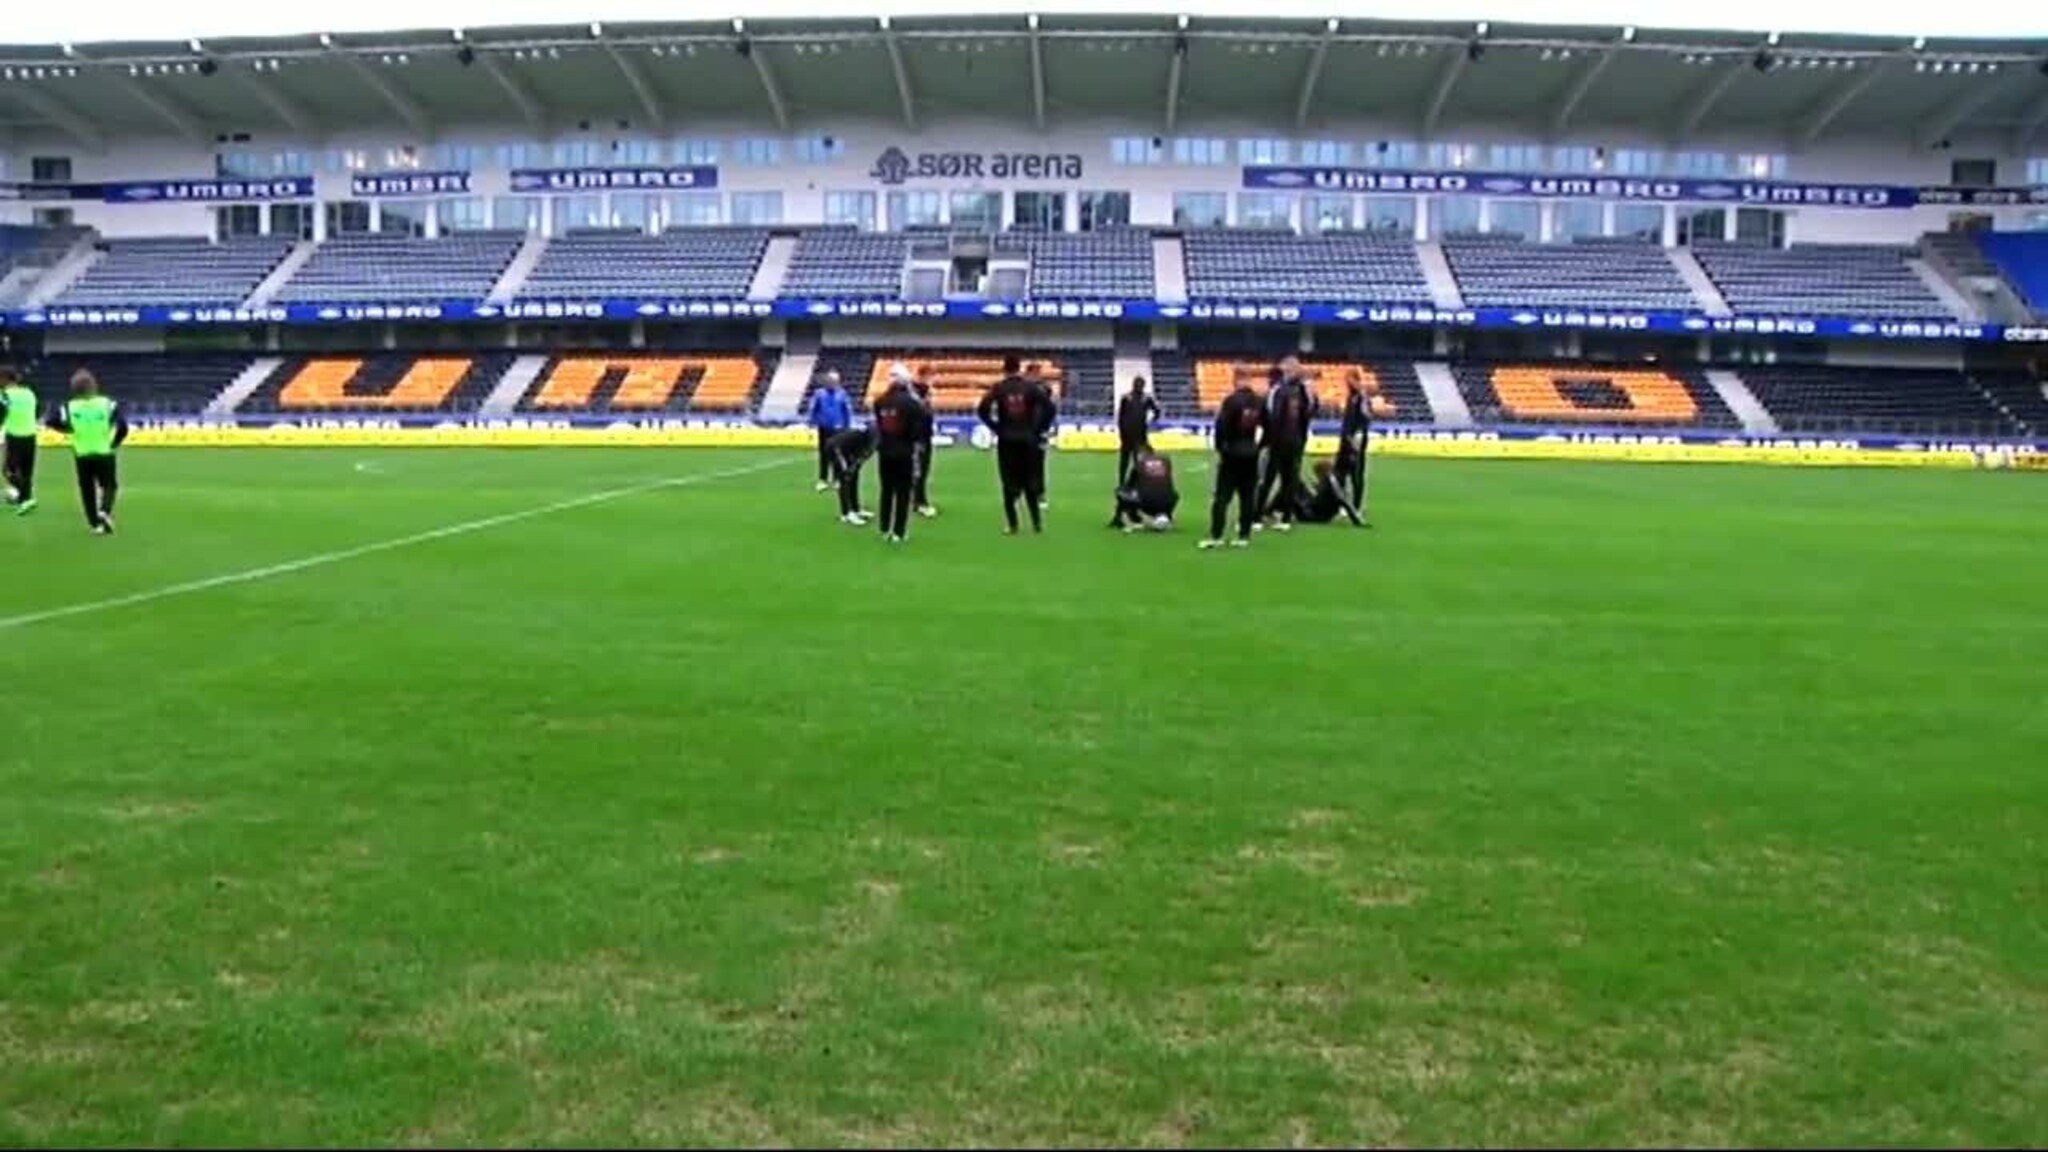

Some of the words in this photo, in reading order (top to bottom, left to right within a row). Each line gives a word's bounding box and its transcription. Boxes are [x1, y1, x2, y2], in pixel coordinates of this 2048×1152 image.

[916, 153, 986, 179] SØR
[991, 153, 1083, 179] arena
[354, 175, 470, 194] UMBR
[550, 171, 695, 188] UMBRO
[1314, 172, 1468, 190] UMBRO
[1531, 179, 1681, 198] UMBRO
[165, 181, 297, 198] UMBRO
[1743, 183, 1889, 205] UMBRO
